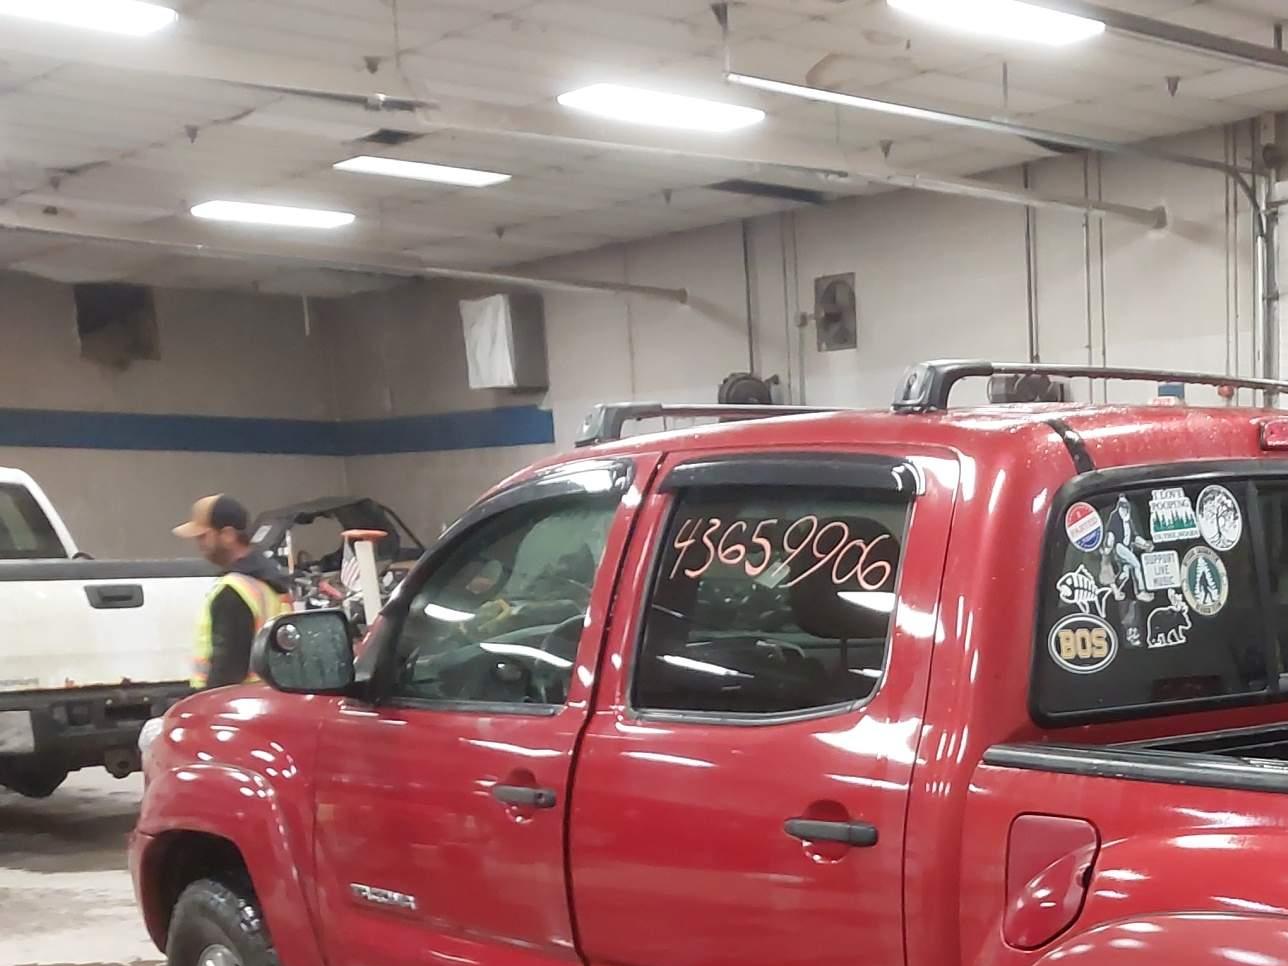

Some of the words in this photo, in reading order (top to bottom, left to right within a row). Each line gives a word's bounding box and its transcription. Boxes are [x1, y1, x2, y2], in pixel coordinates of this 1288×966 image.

[1151, 499, 1189, 511] POOPING
[669, 515, 891, 590] 43659906
[1144, 553, 1175, 565] SUPPORT
[1154, 565, 1170, 576] LIVE
[1058, 628, 1109, 660] BOS
